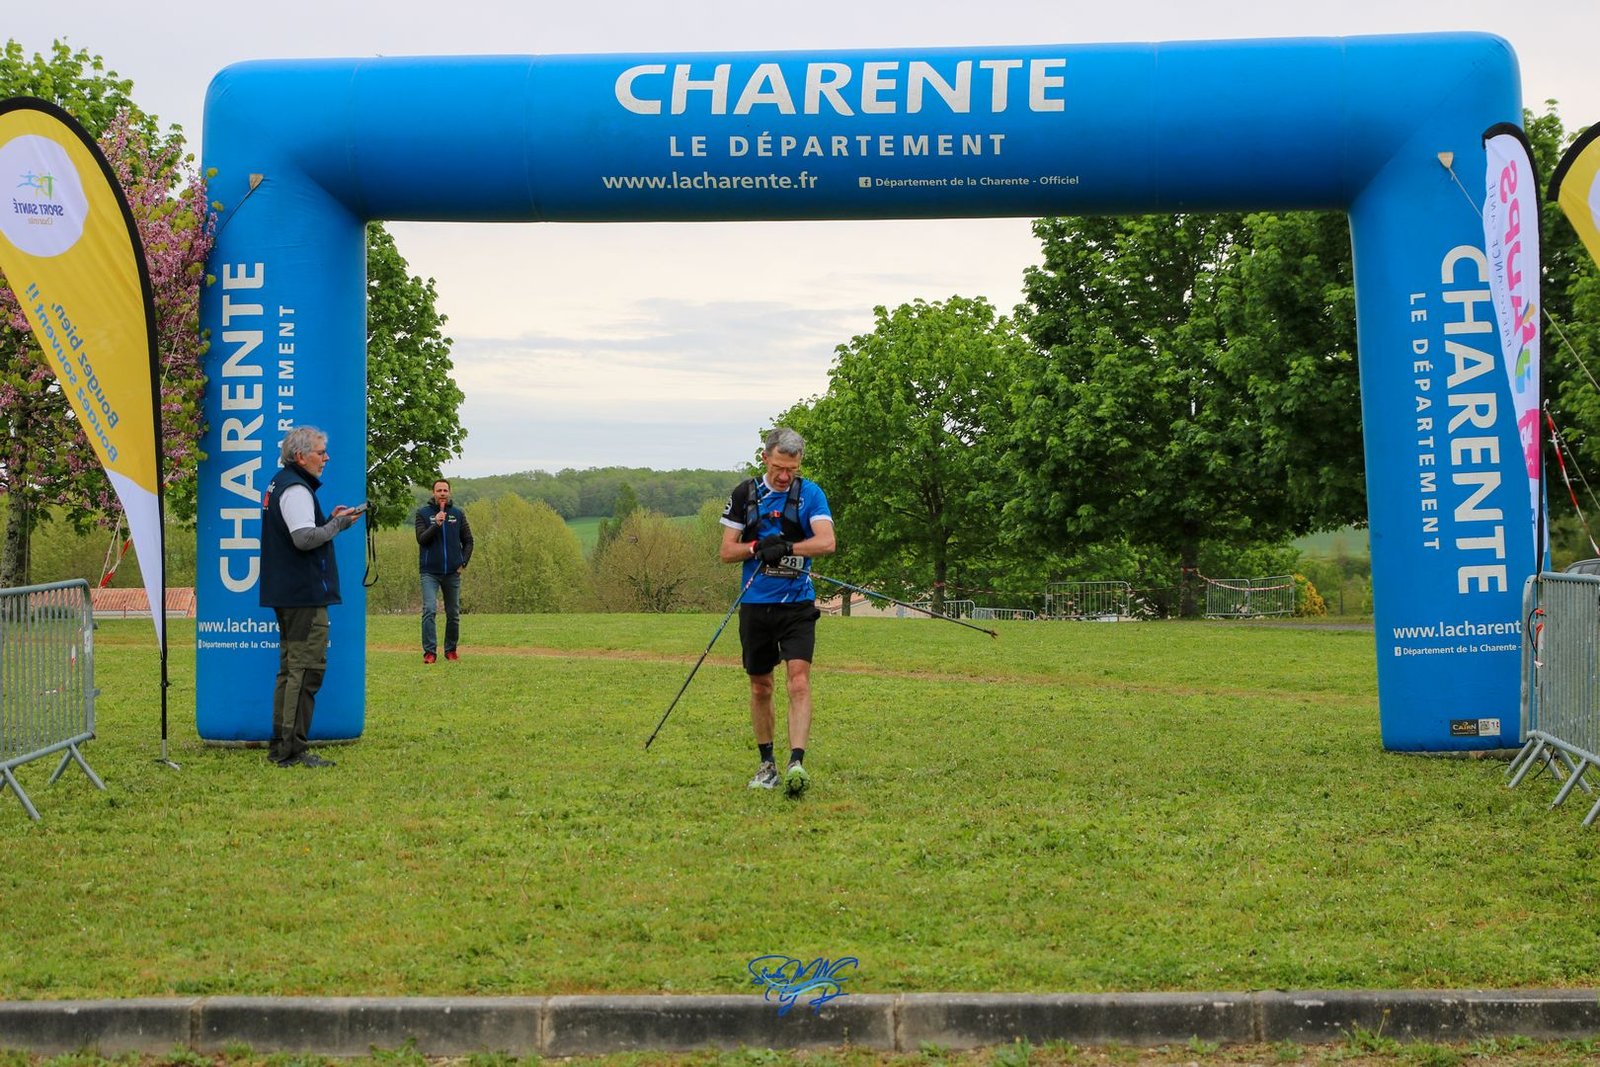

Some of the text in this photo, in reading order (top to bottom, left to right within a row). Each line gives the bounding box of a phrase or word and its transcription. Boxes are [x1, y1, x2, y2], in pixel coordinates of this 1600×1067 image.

[614, 58, 1067, 116] CHARENTE
[669, 130, 1006, 157] LE DÉPARTEMENT
[602, 171, 818, 189] www.lacharente.fr
[875, 177, 948, 188] Département
[950, 178, 964, 187] de
[967, 177, 977, 187] la
[980, 176, 1030, 187] Charente
[1039, 175, 1080, 186] Officiel
[219, 262, 265, 593] CHARENTE
[1409, 292, 1440, 550] LE DÉPARTEMENT
[1441, 244, 1508, 594] CHARENTE
[1393, 620, 1521, 639] www.lacharent
[239, 640, 249, 649] de
[250, 640, 259, 649] la
[1402, 645, 1455, 657] Département
[1456, 644, 1468, 654] de
[1469, 644, 1478, 653] la
[1479, 643, 1517, 653] Charente
